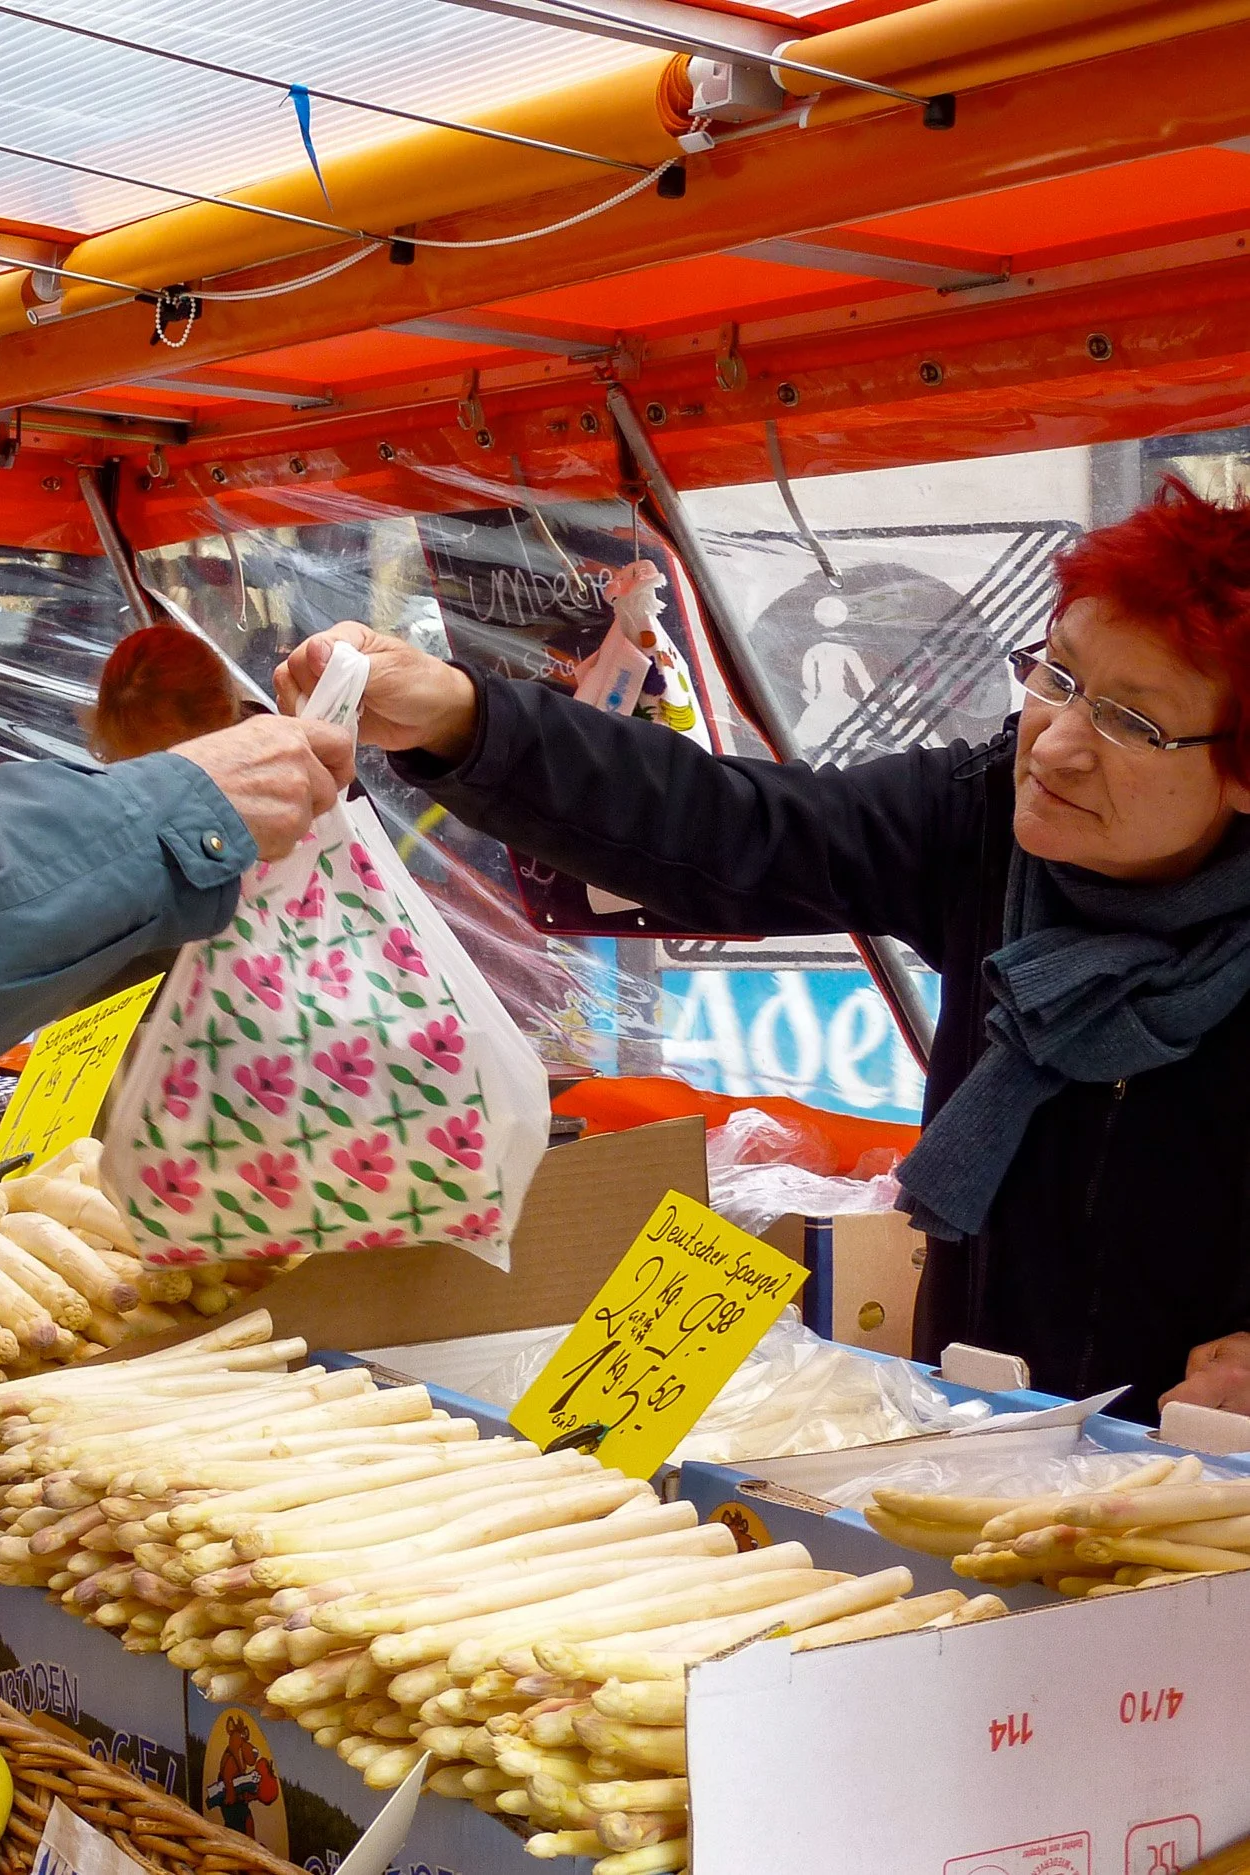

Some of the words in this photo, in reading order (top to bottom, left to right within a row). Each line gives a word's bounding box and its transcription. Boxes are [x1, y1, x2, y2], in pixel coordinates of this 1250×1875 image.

[595, 1256, 664, 1339] 2
[724, 1251, 793, 1301] Spargel
[548, 1340, 622, 1414] 1
[1119, 1687, 1185, 1724] 4/10
[988, 1712, 1034, 1752] 114
